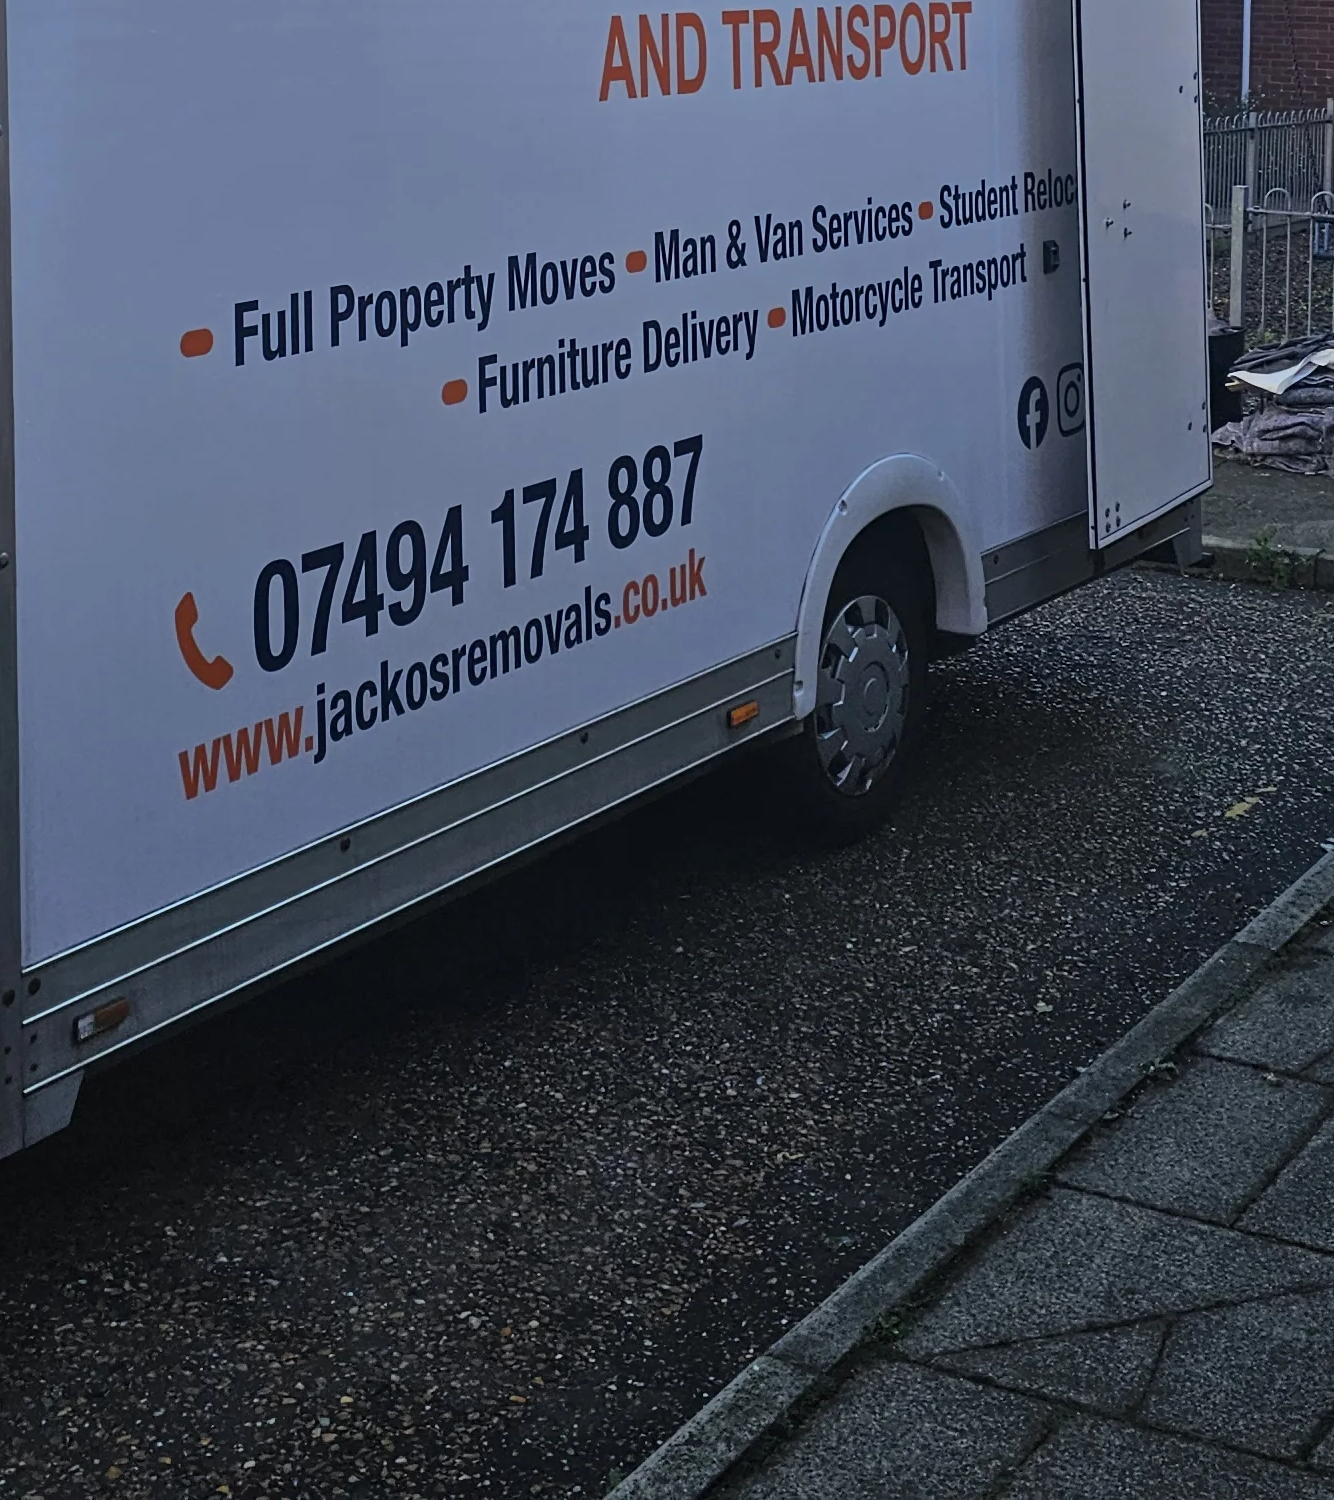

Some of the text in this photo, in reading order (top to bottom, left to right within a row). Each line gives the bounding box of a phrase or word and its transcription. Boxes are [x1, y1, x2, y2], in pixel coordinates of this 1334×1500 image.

[598, 1, 973, 102] AND TRANSPORT
[234, 168, 1078, 367] Full Property Moves Man & Van Services Student Reloc
[478, 242, 1028, 414] Furniture Delivery Motorcycle Transport
[253, 433, 704, 673] 07494 174 887
[178, 547, 708, 800] www.jackosremovals.co.uk
